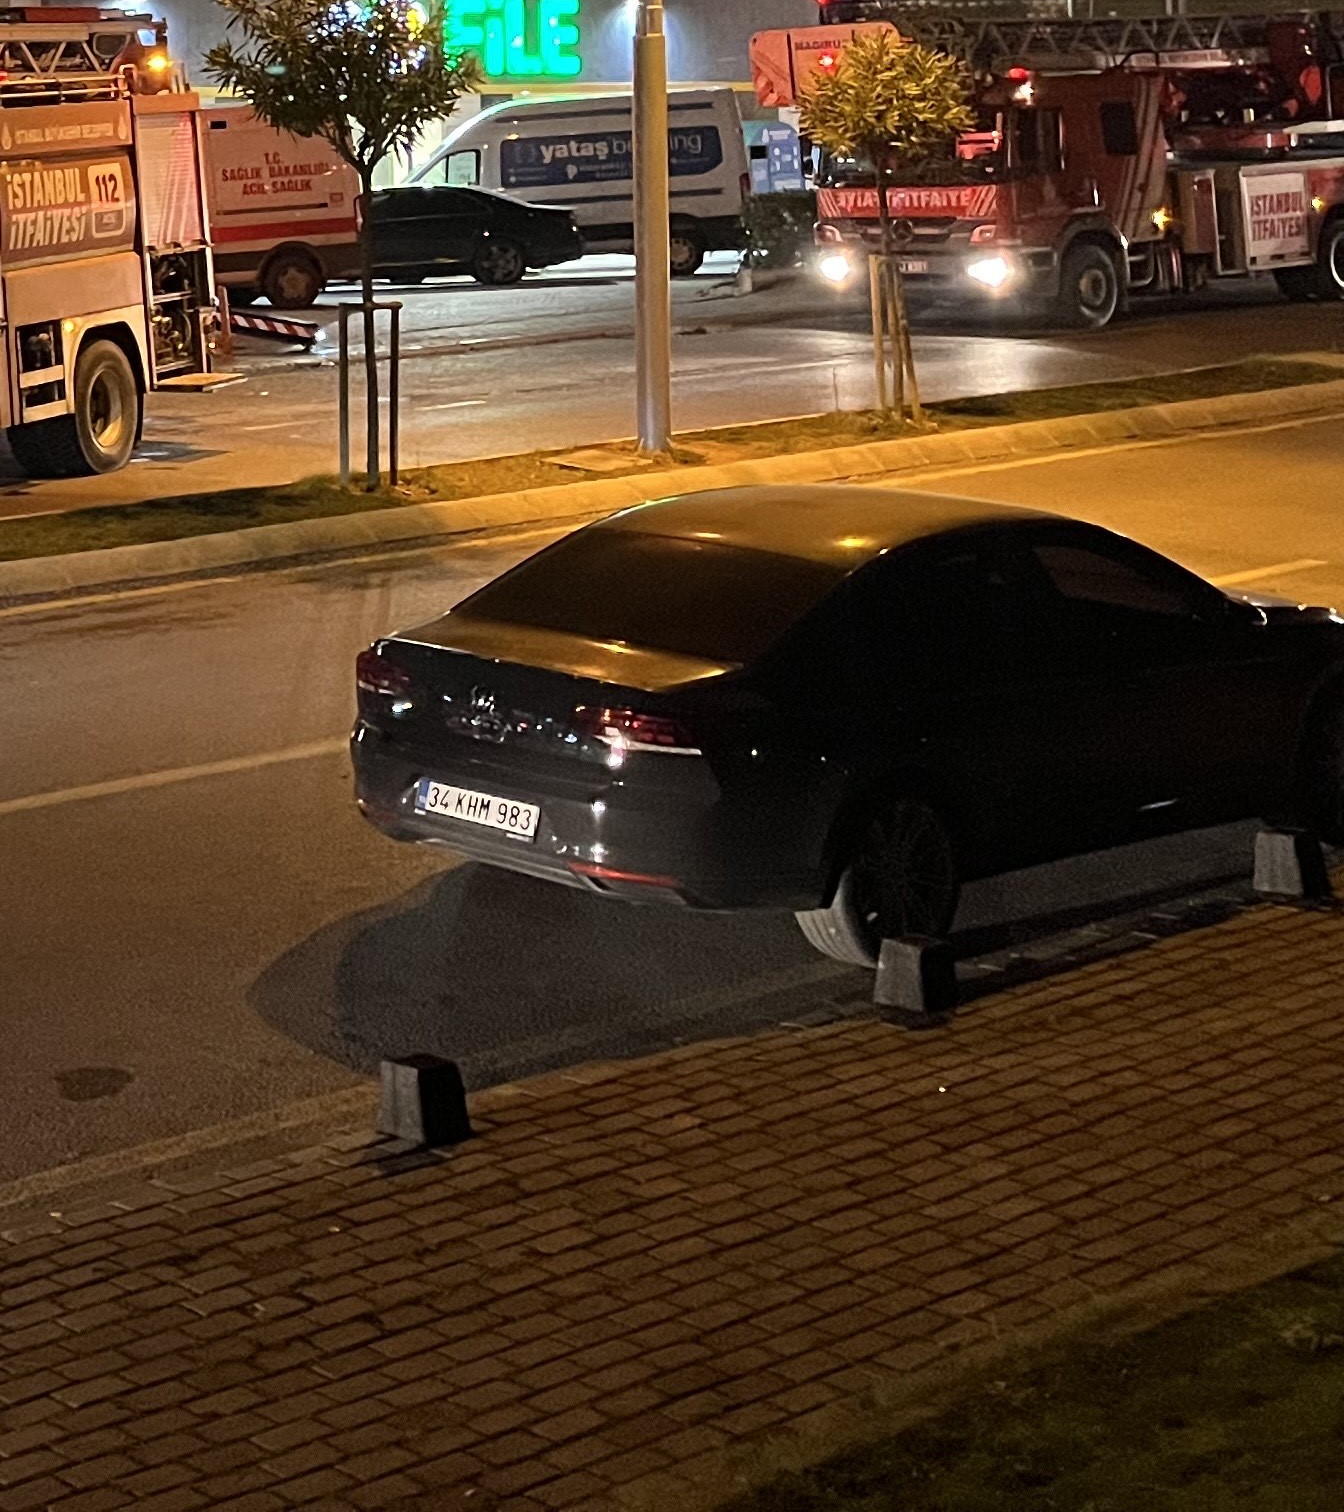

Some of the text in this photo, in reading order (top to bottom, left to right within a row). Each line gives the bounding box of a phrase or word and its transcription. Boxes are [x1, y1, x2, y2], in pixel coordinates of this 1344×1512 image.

[794, 39, 843, 50] MAGIRU
[539, 139, 609, 164] yataş
[95, 173, 121, 203] 112
[428, 786, 532, 831] 34 KHM 983
